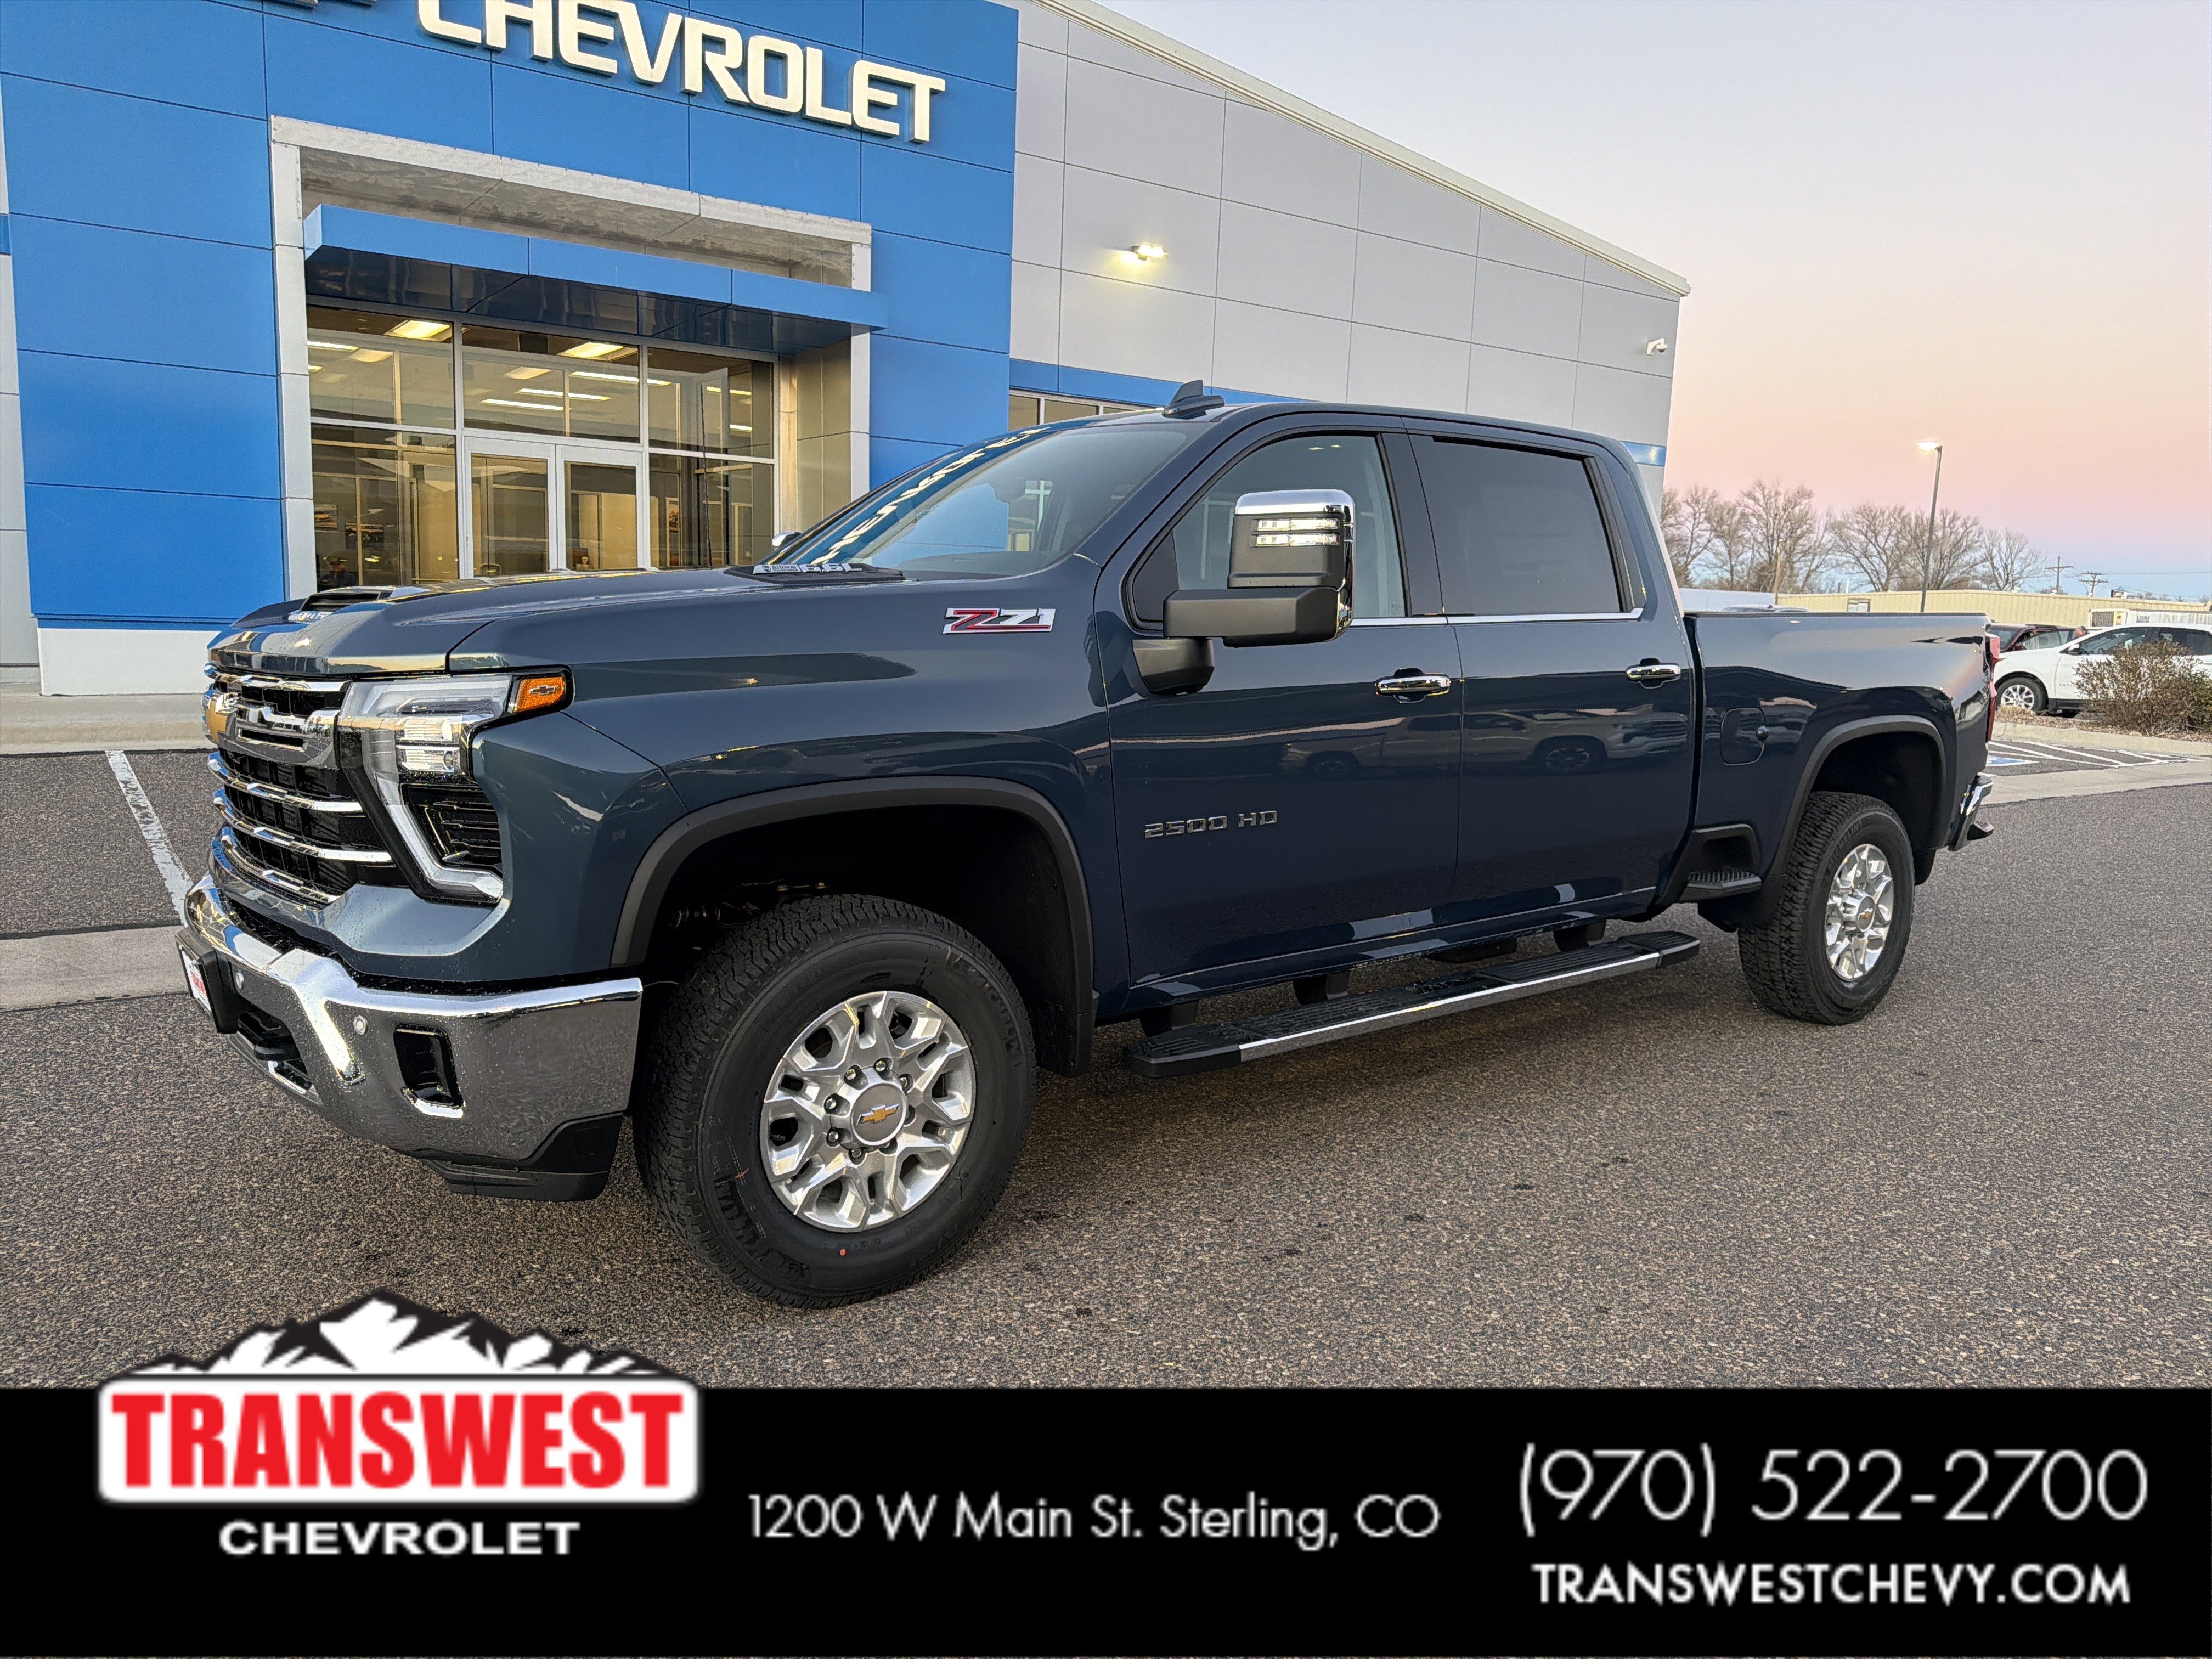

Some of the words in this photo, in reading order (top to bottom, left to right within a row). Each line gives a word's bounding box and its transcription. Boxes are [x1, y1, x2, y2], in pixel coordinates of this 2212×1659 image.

[417, 0, 946, 143] CHEVROLET
[943, 607, 1056, 634] Z71
[1144, 816, 1227, 839] 2500
[1238, 810, 1277, 828] HD
